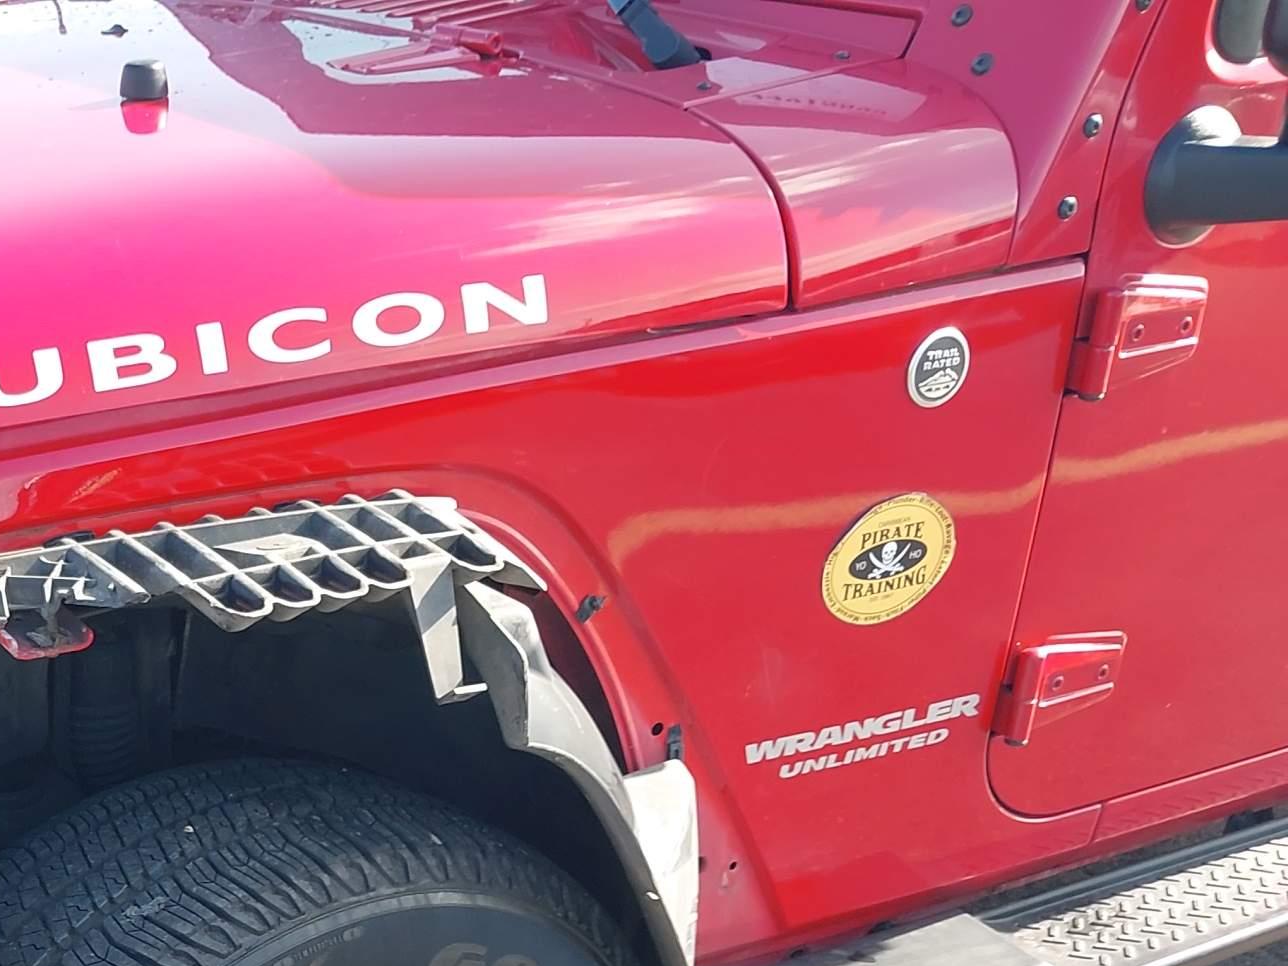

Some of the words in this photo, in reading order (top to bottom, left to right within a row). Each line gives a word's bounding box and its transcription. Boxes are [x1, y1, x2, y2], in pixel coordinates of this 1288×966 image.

[923, 356, 961, 371] RATED
[926, 347, 960, 361] TRAIL
[860, 521, 925, 550] PIRATE
[909, 549, 922, 560] HO
[855, 561, 867, 571] YO
[842, 565, 927, 602] TRAINING
[745, 693, 981, 765] WRANGLER
[778, 728, 949, 779] UNLIMITED
